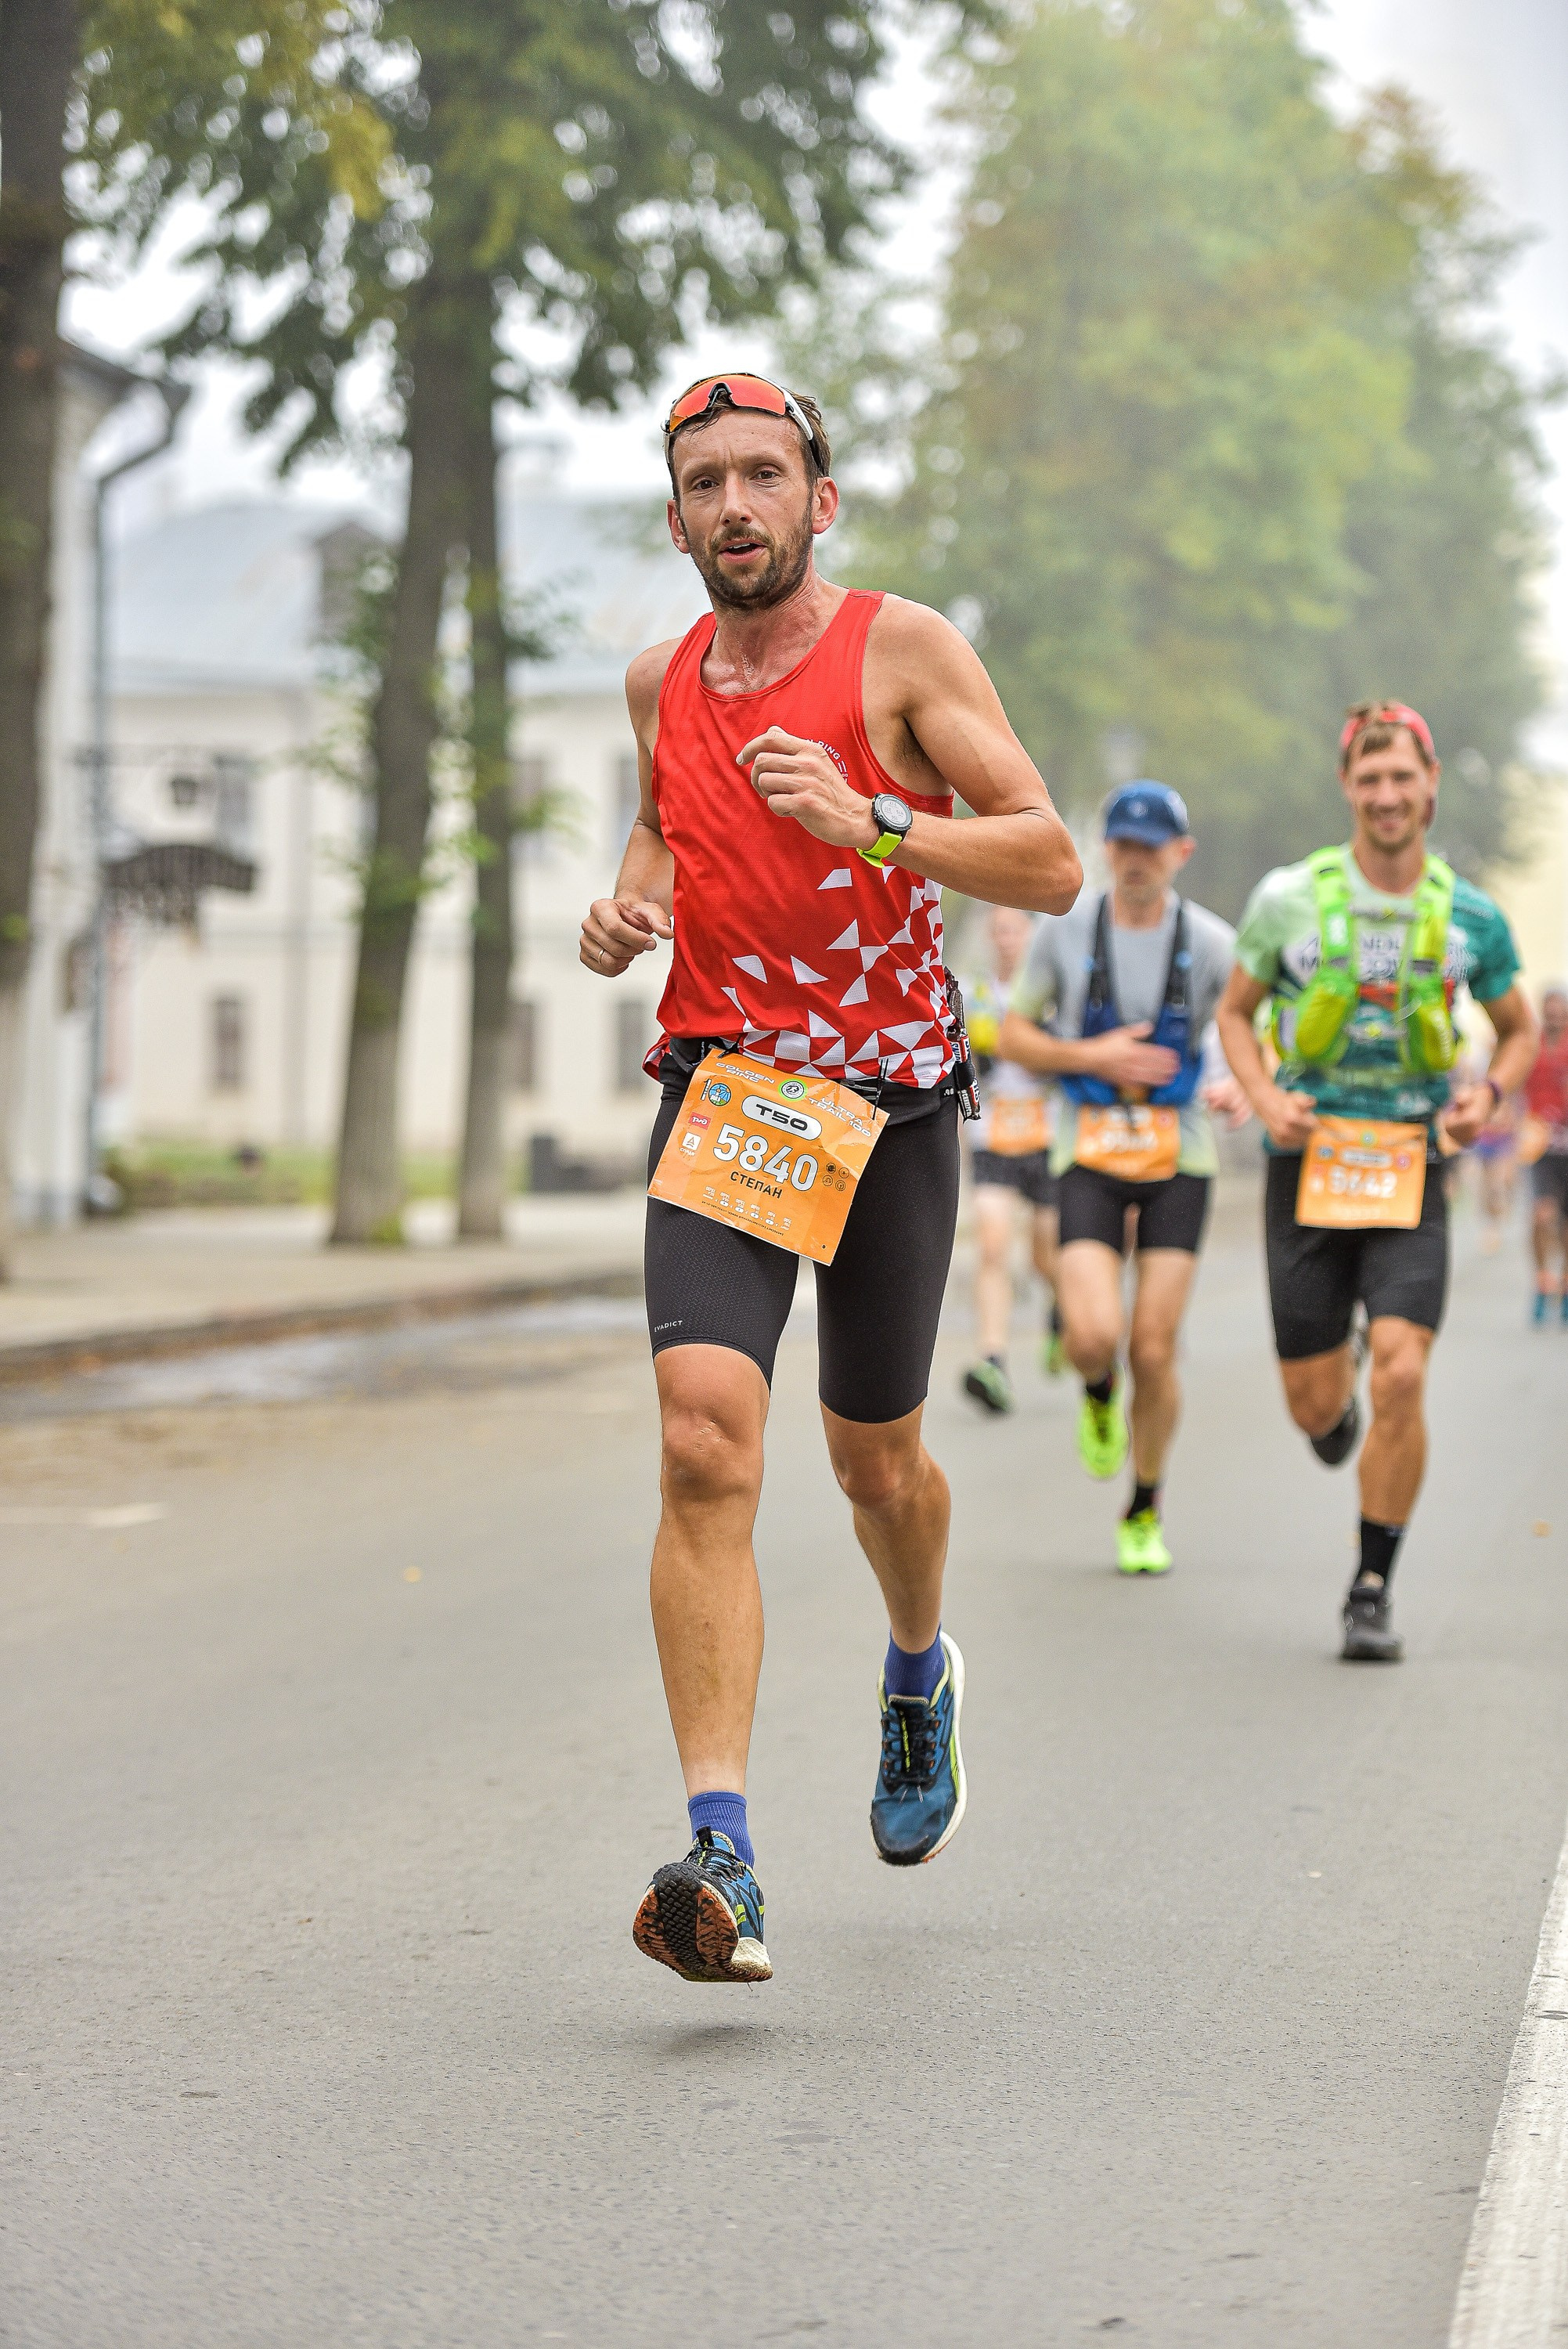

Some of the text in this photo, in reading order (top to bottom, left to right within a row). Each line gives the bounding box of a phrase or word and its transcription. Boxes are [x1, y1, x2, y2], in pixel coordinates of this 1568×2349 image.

[716, 1063, 775, 1084] GOLDEN
[726, 1069, 759, 1083] RING
[755, 1103, 809, 1132] T50
[808, 1097, 871, 1137] TRAIL 100
[821, 1097, 863, 1125] ULTRA
[712, 1123, 819, 1192] 5840
[730, 1171, 784, 1199] СТЕПАН
